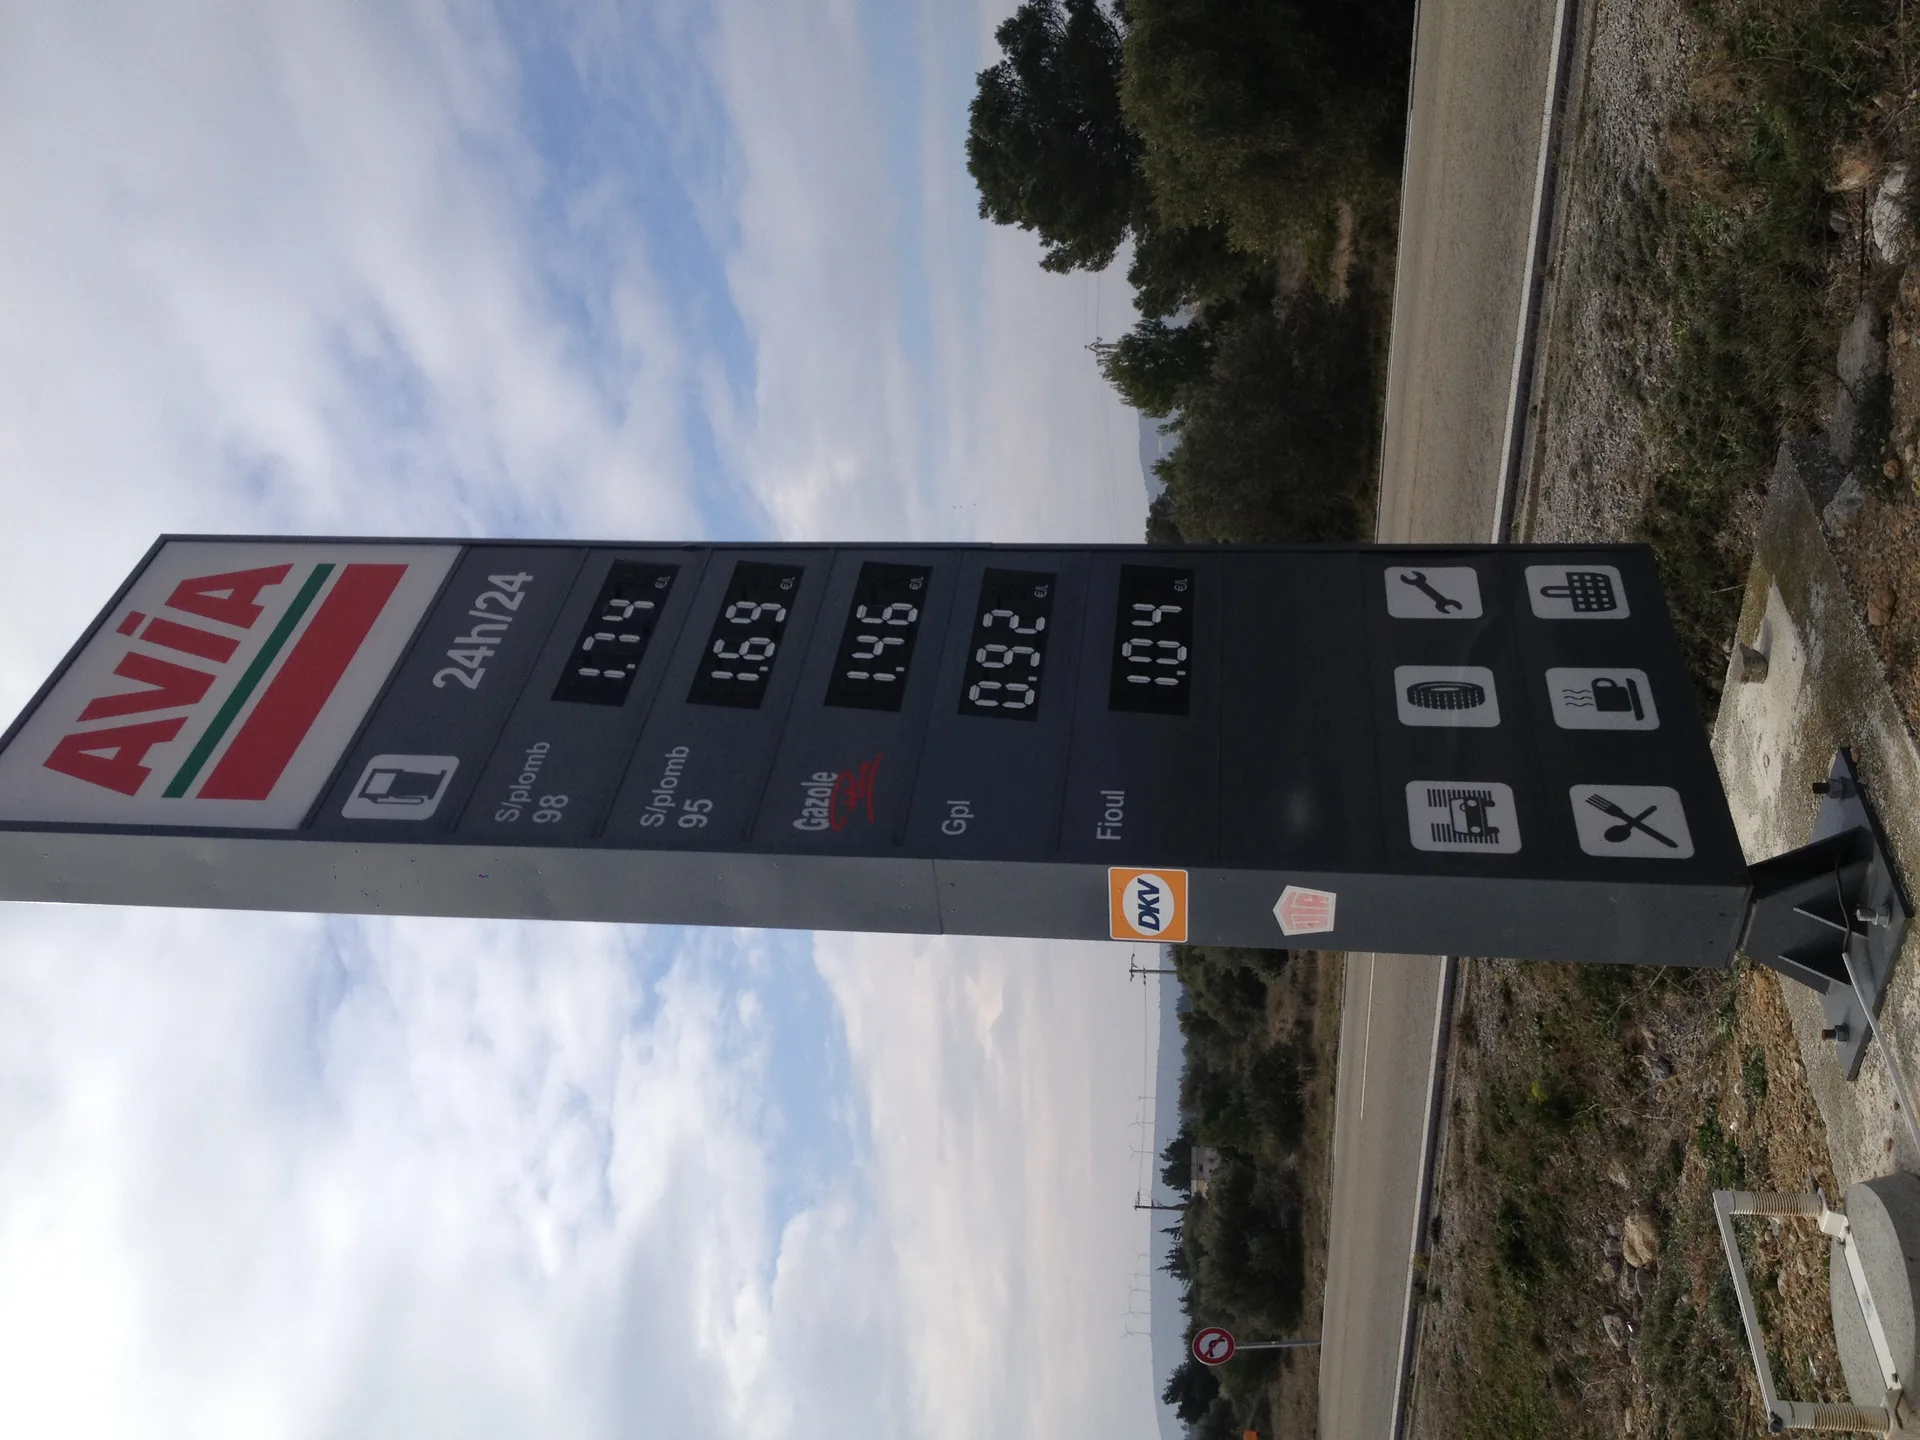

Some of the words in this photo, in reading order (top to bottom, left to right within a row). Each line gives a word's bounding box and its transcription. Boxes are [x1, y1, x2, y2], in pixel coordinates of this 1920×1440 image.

[432, 571, 534, 689] 24h/24
[577, 599, 655, 679] 1.74
[710, 602, 786, 681] 1.69
[846, 602, 918, 682] 1.46
[968, 609, 1045, 708] 0.92
[1122, 603, 1187, 685] 1.04
[494, 742, 551, 822] S/plomb
[532, 794, 570, 823] 98
[640, 746, 690, 827] S/plomb
[678, 799, 713, 828] 95
[792, 772, 838, 830] Gazole
[941, 800, 974, 835] Gpl
[1097, 791, 1125, 840] Fioul
[1138, 878, 1160, 931] DKV
